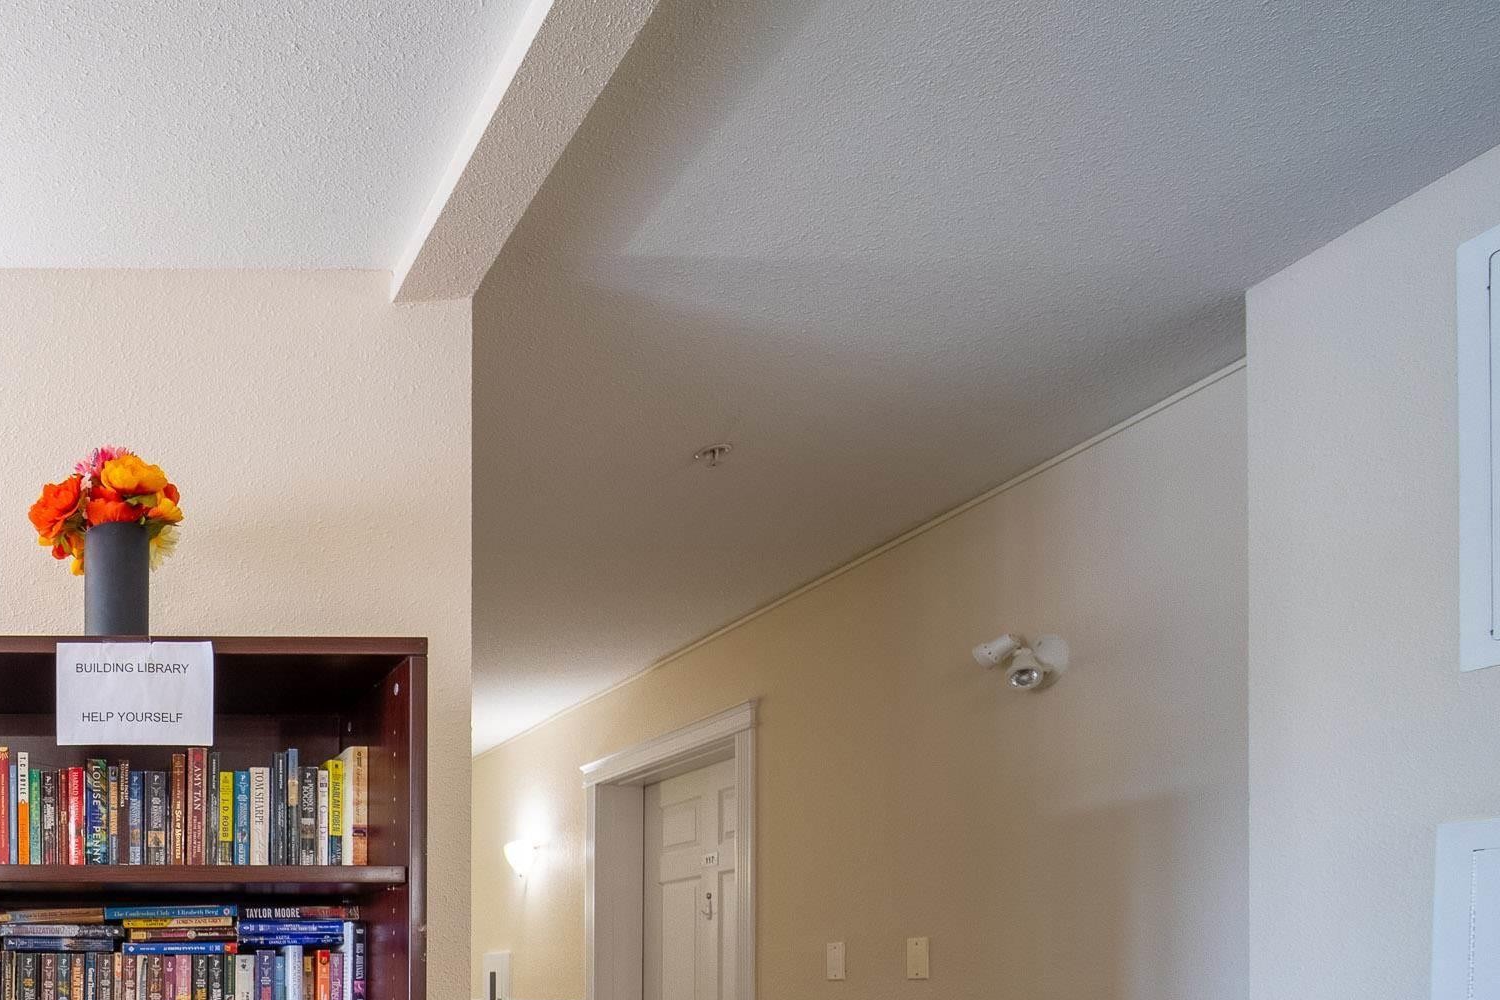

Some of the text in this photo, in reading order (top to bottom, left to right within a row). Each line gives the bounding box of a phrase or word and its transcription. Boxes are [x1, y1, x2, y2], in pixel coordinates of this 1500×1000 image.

[75, 663, 189, 674] BUILDING LIBRARY
[82, 711, 183, 723] HELP YOURSELF
[19, 757, 27, 795] T.C. BOYLE
[194, 765, 202, 811] AMY TAN
[92, 765, 101, 864] LOUISE PENNY
[255, 771, 264, 825] TOM SHARPE
[245, 907, 301, 918] TAYLOR MOORE
